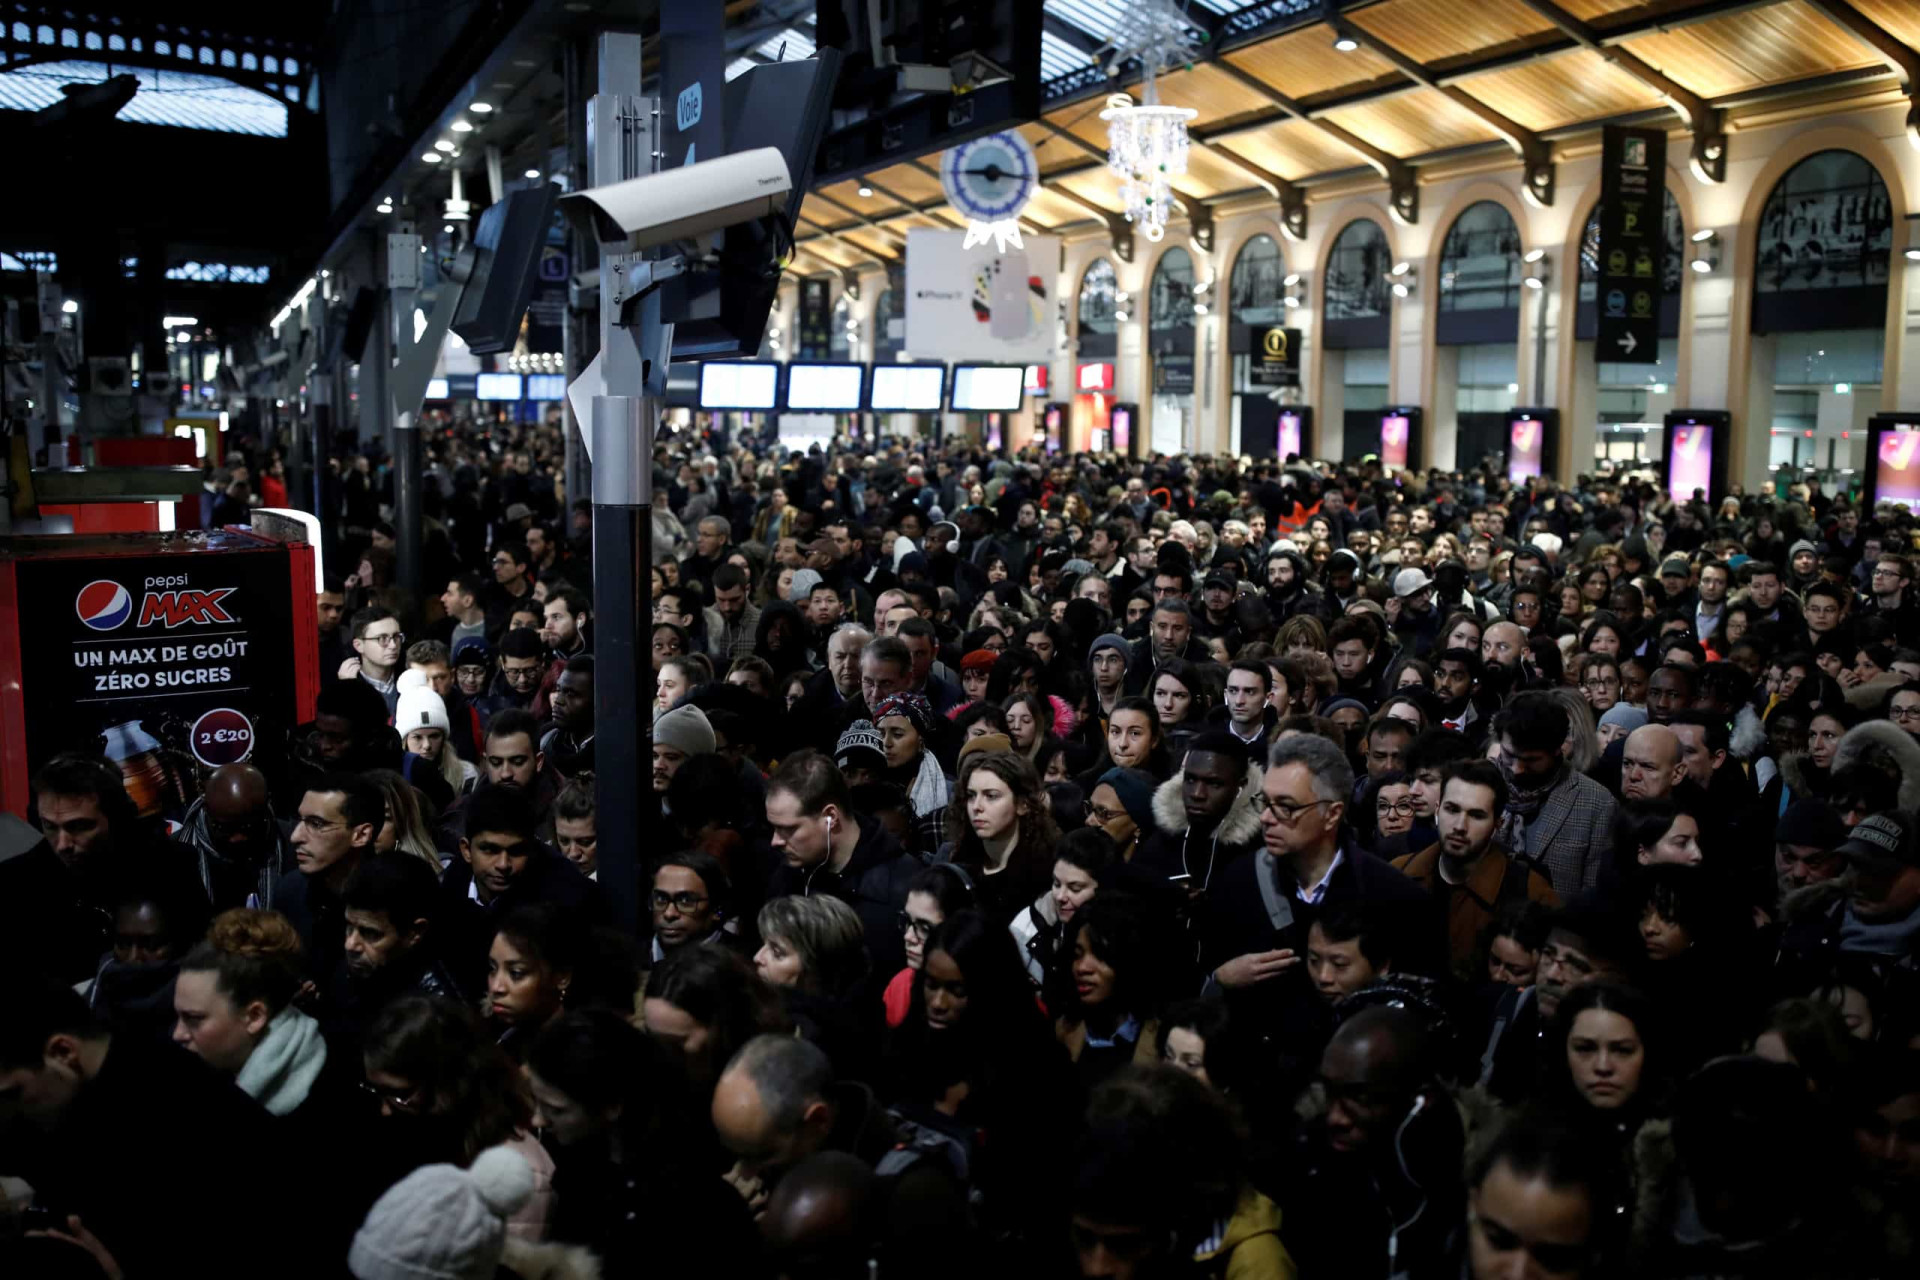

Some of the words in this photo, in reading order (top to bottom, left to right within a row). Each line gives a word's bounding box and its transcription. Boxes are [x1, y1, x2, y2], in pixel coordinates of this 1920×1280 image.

[679, 90, 699, 125] Voie
[144, 572, 188, 590] pepsi
[137, 587, 238, 629] MAX
[74, 650, 103, 668] UN
[109, 647, 157, 666] MAX
[162, 645, 188, 663] DE
[192, 637, 248, 660] GOÛT
[94, 670, 150, 691] ZÉRO
[155, 666, 231, 687] SUCRES
